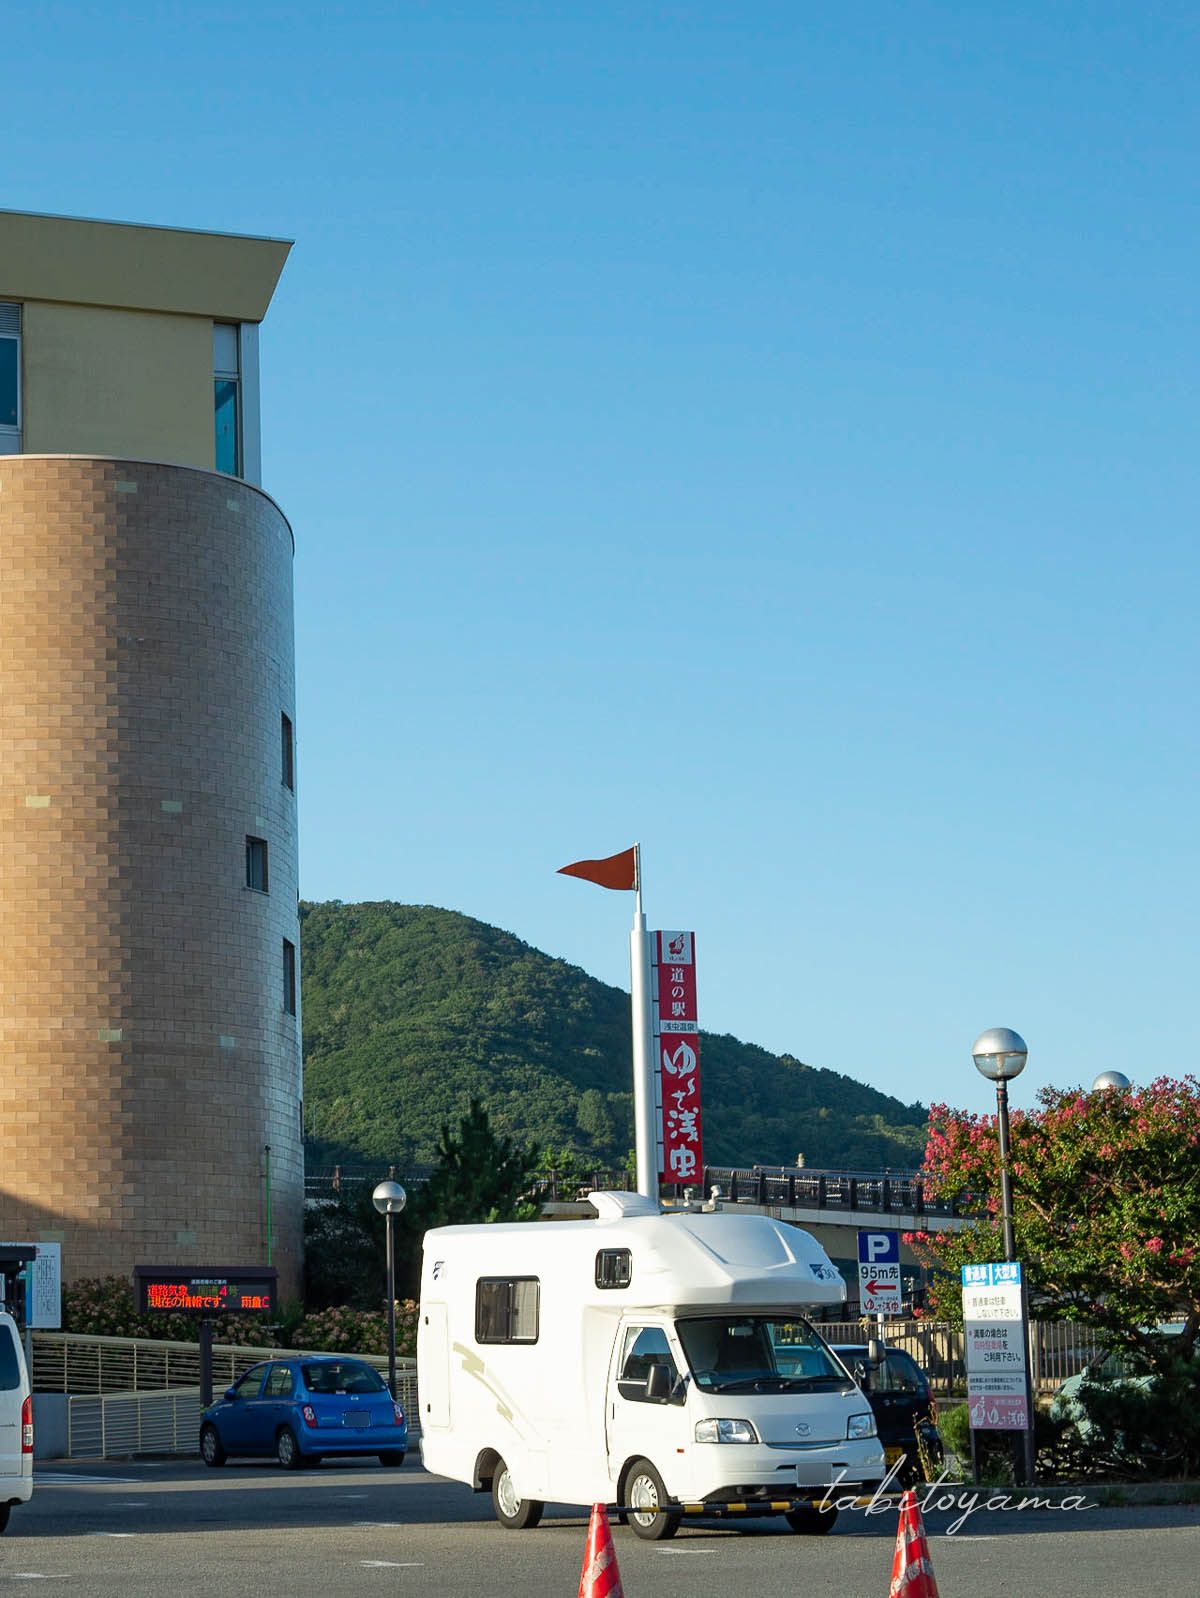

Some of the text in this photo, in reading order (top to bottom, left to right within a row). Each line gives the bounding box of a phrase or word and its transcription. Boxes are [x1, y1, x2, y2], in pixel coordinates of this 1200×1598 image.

[670, 967, 686, 1017] 道の駅
[867, 1234, 890, 1262] P
[860, 1266, 899, 1280] 95m先
